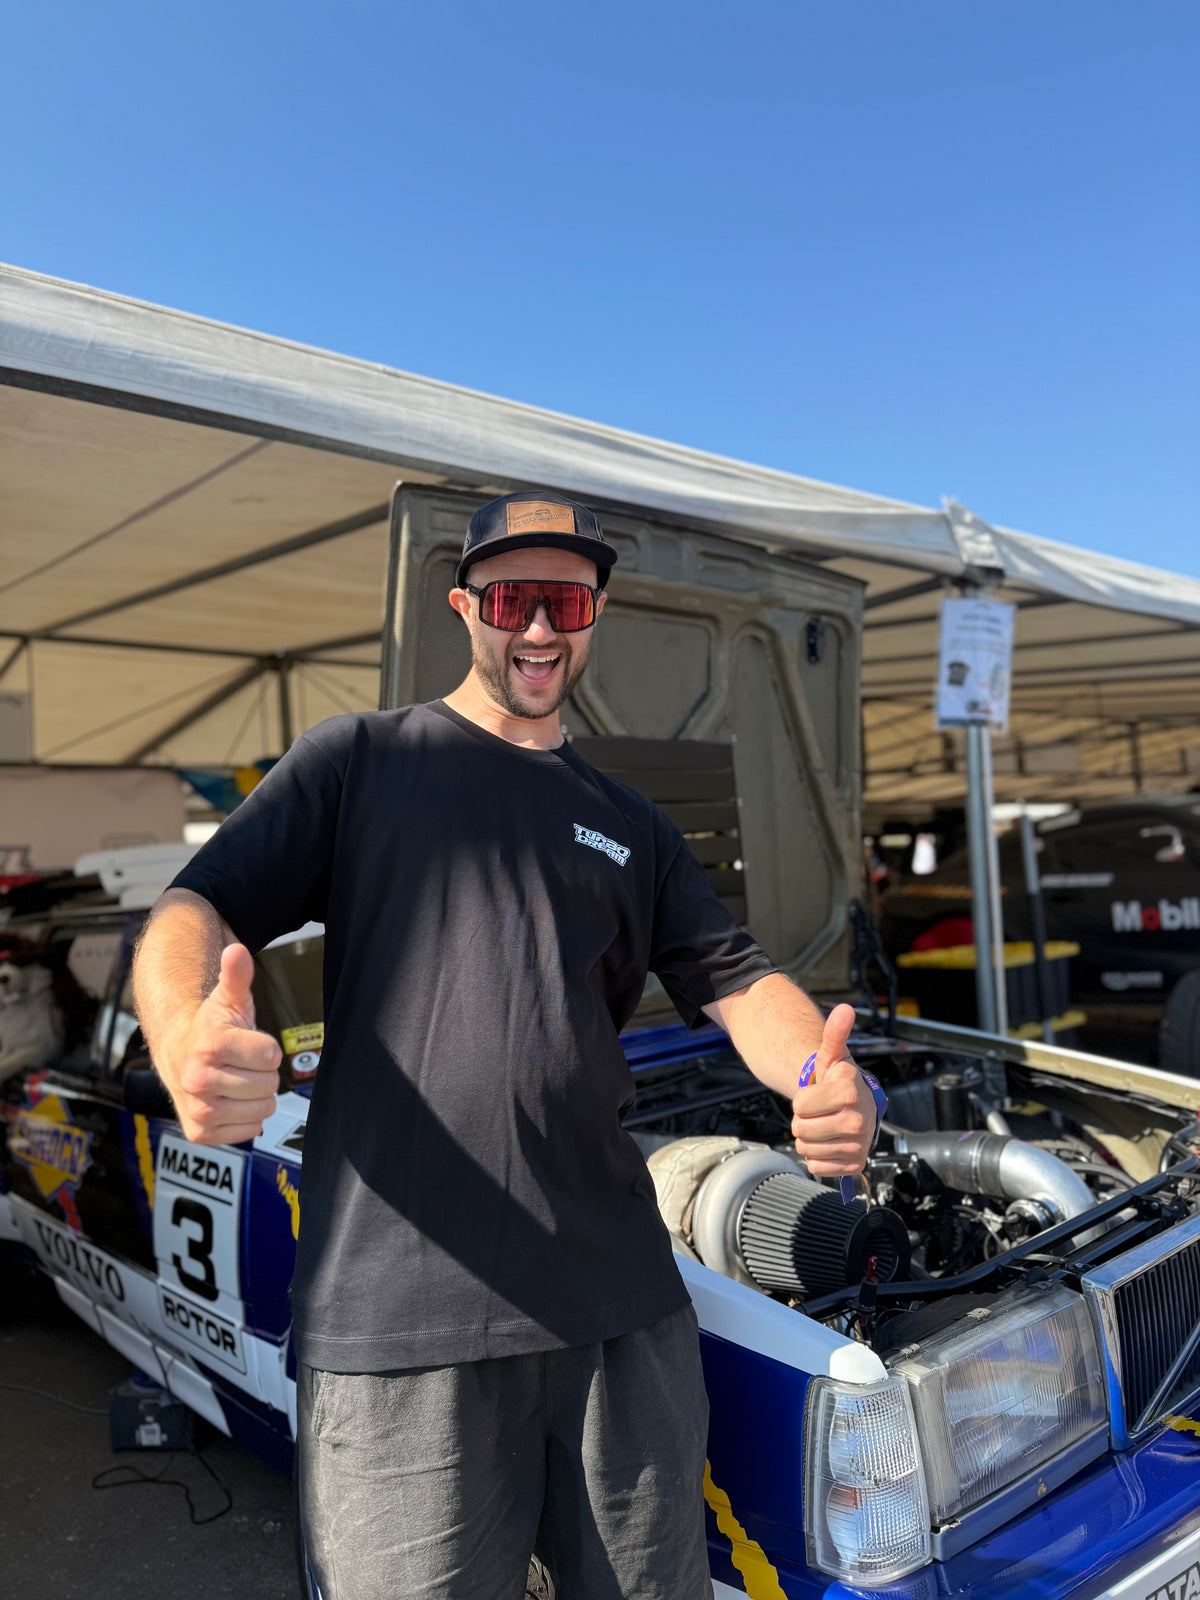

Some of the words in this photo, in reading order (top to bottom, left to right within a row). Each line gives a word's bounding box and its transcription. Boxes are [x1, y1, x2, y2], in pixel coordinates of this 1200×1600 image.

[1112, 897, 1200, 932] Mobil
[161, 1146, 234, 1194] MAZDA
[33, 1218, 125, 1302] VOLVO
[171, 1196, 220, 1302] 3
[163, 1294, 238, 1358] ROTOR
